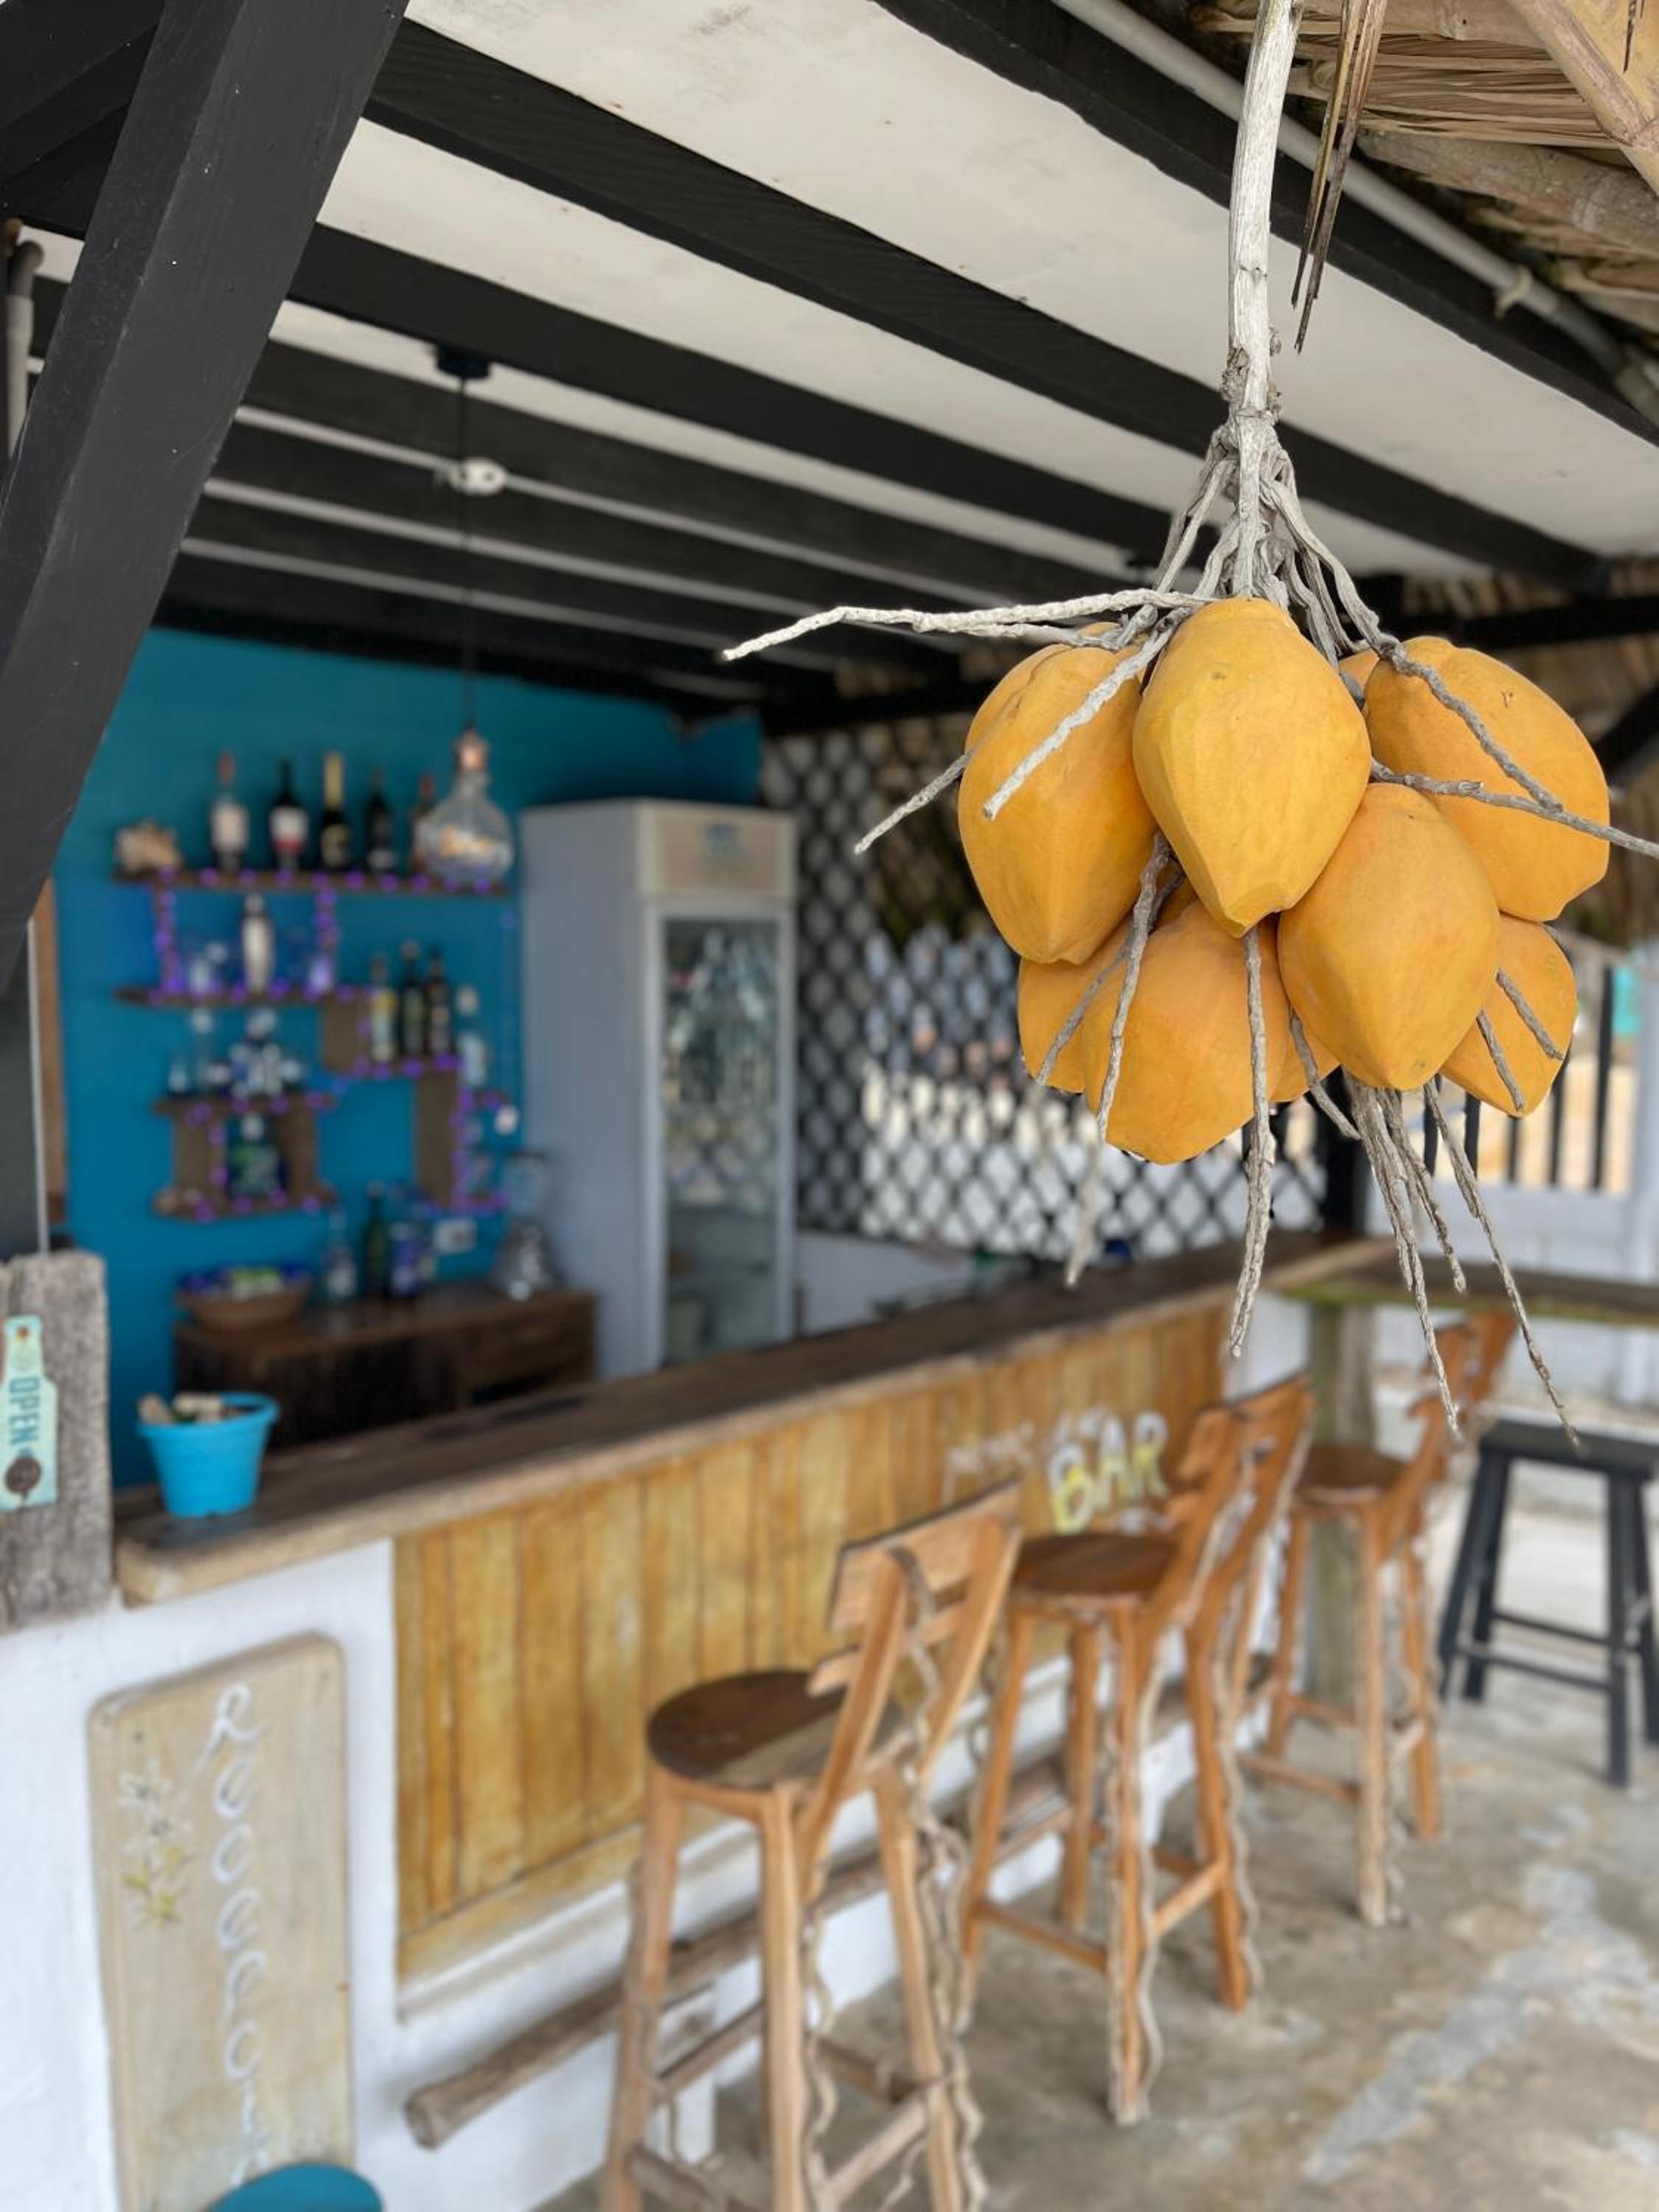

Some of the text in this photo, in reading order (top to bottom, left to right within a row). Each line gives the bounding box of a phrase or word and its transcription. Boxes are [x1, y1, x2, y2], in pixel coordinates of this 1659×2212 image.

[9, 1377, 41, 1446] OPEN
[1049, 1409, 1169, 1535] BAR
[192, 1682, 273, 2184] Recepci
